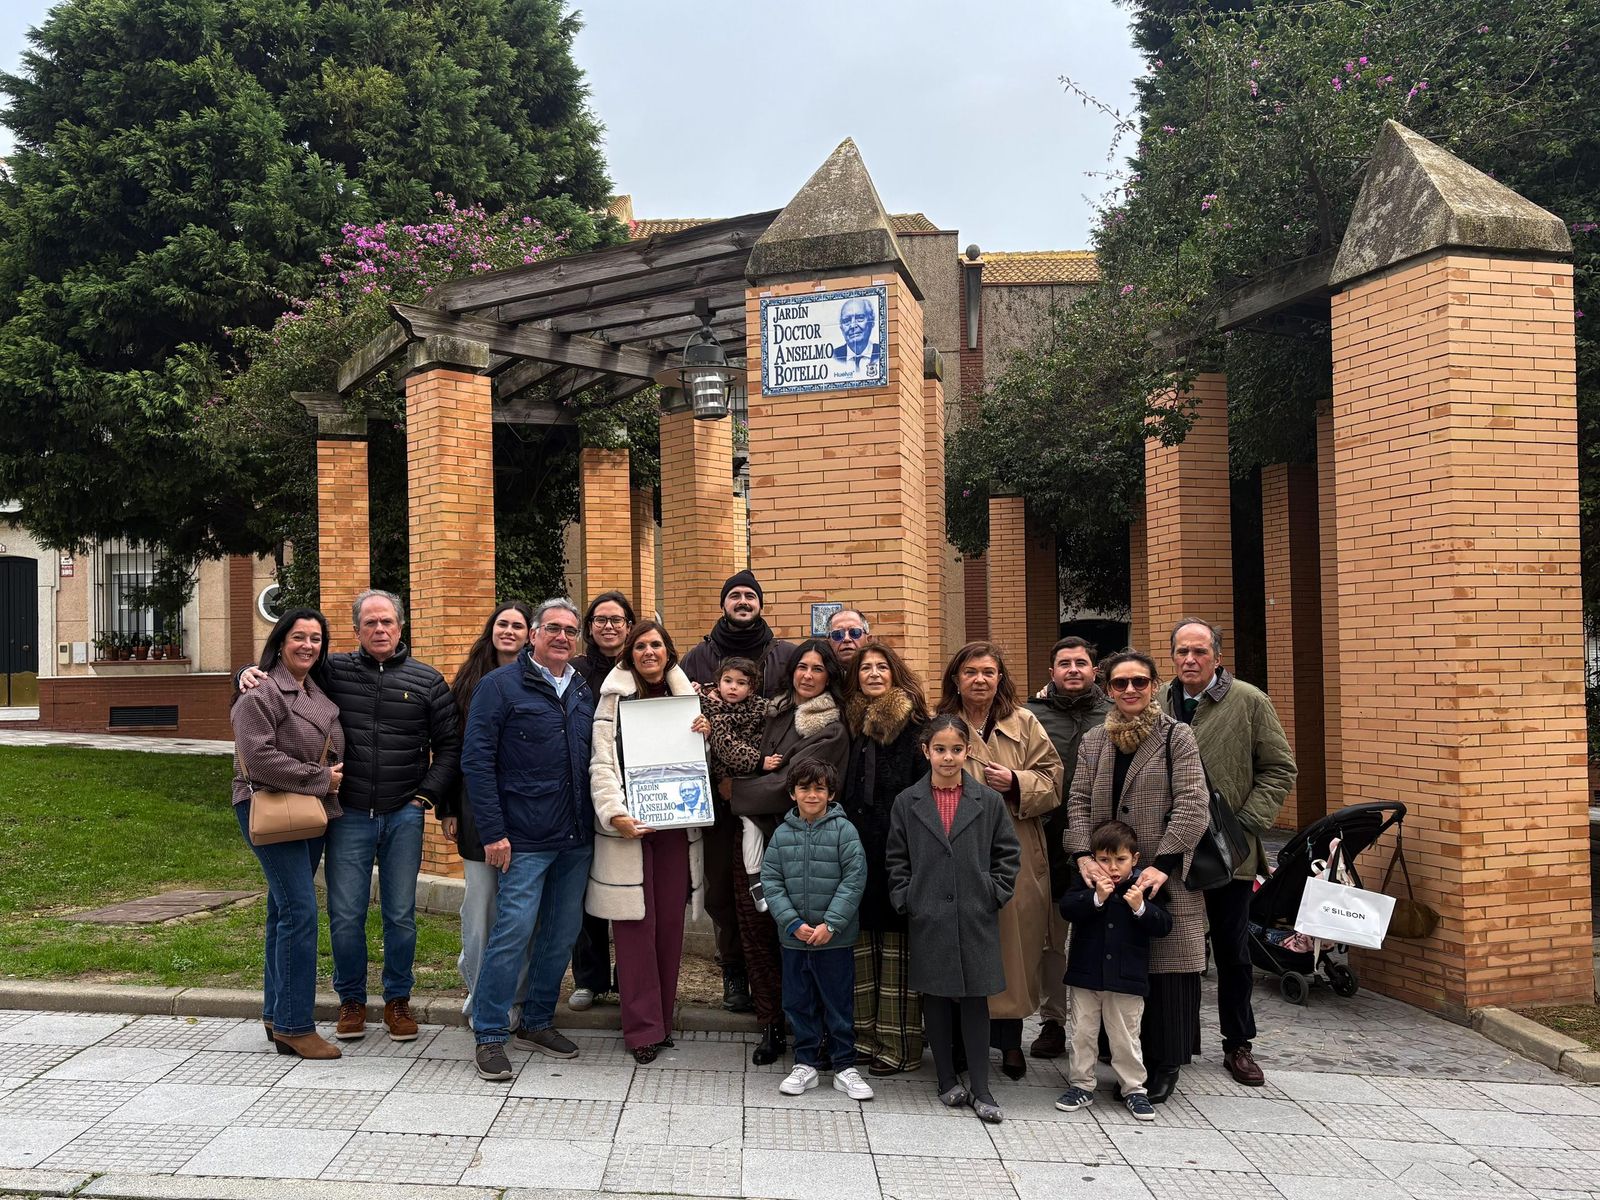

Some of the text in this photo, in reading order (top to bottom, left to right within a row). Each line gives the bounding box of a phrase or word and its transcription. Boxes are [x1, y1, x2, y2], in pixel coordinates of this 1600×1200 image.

[773, 304, 809, 323] JARDÍN
[773, 324, 822, 344] DOCTOR
[774, 343, 834, 365] ANSELMO
[774, 364, 828, 386] BOTELLO
[637, 793, 668, 803] DOCTOR
[639, 802, 677, 814] ANSELMO
[1331, 907, 1366, 920] SILBON
